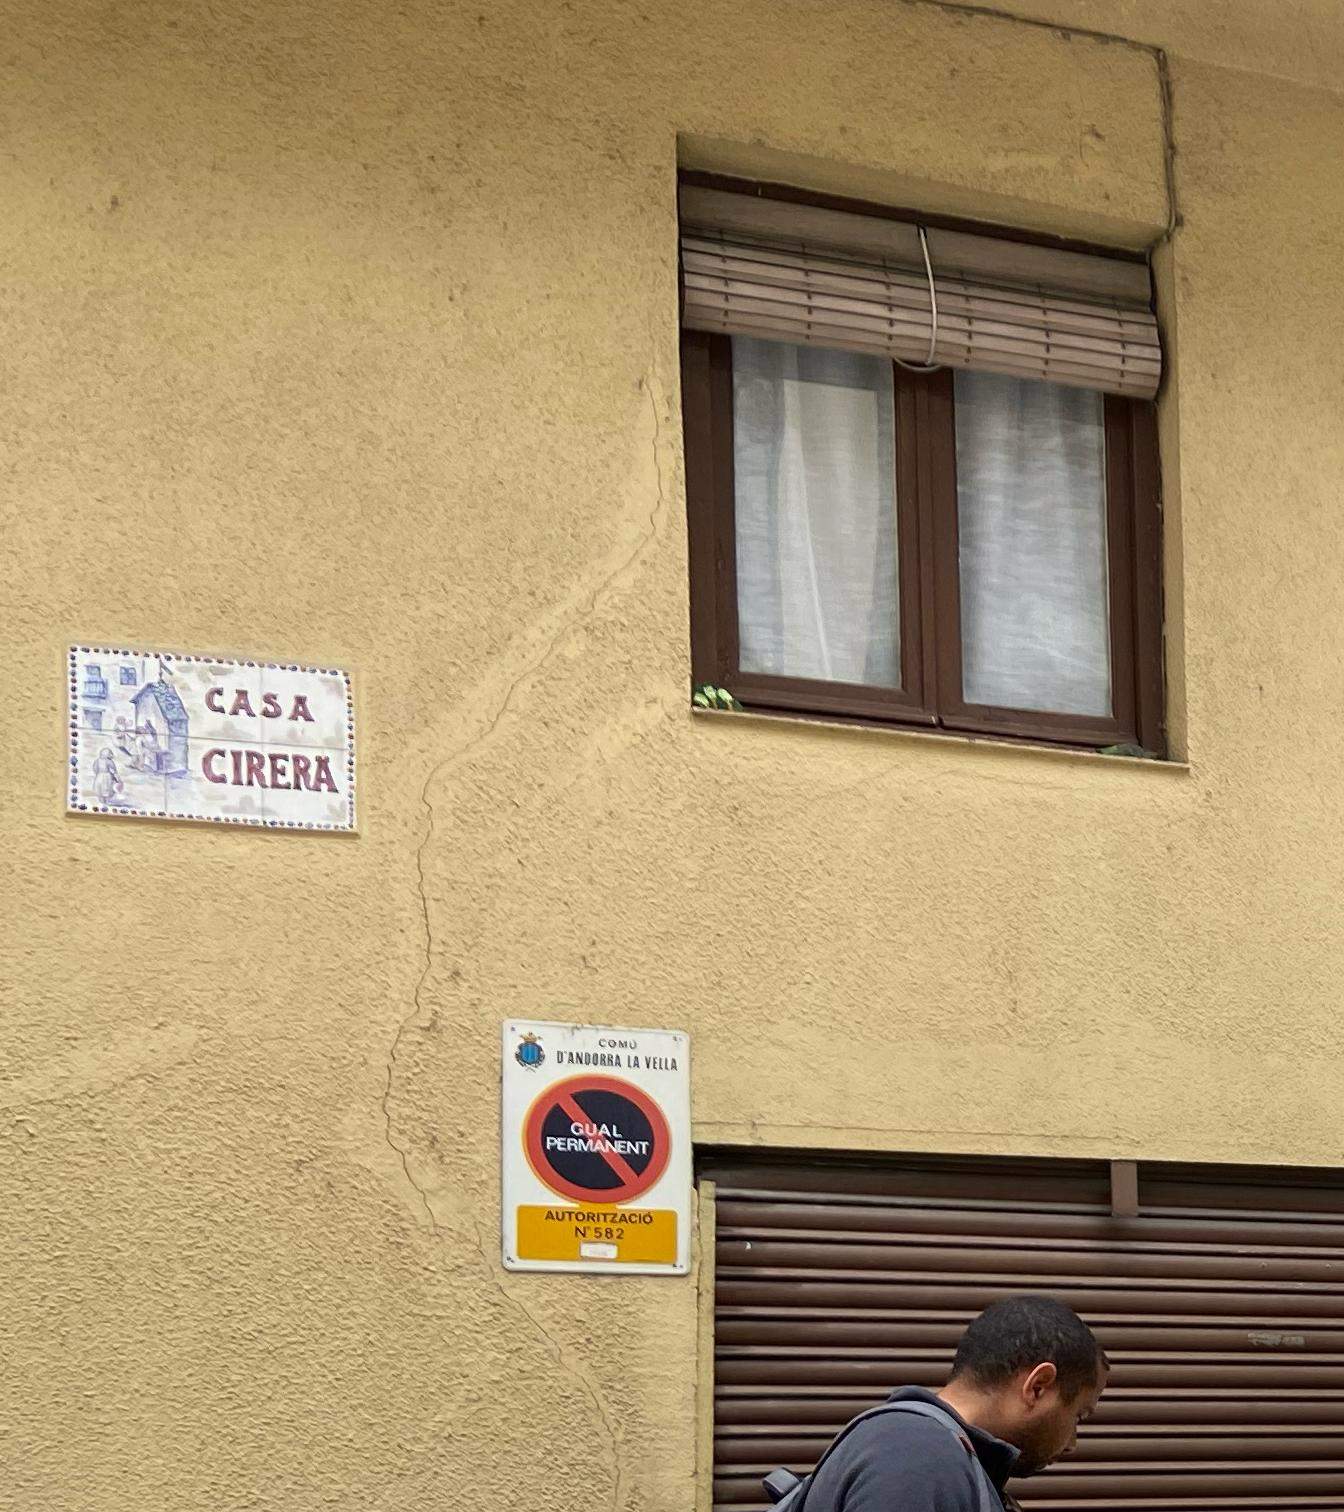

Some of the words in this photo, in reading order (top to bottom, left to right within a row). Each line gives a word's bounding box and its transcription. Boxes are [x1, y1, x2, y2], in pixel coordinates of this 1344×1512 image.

[204, 687, 315, 722] CASA
[202, 748, 339, 793] CIRERA
[598, 1038, 638, 1049] COMÚ
[556, 1051, 622, 1068] D'ANDORRA
[627, 1055, 640, 1068] LA
[645, 1057, 678, 1071] VELLA
[570, 1122, 623, 1138] GUAL
[546, 1137, 649, 1155] PERMANENT
[544, 1210, 653, 1225] AUTORITZACIÓ
[594, 1228, 624, 1240] 582
